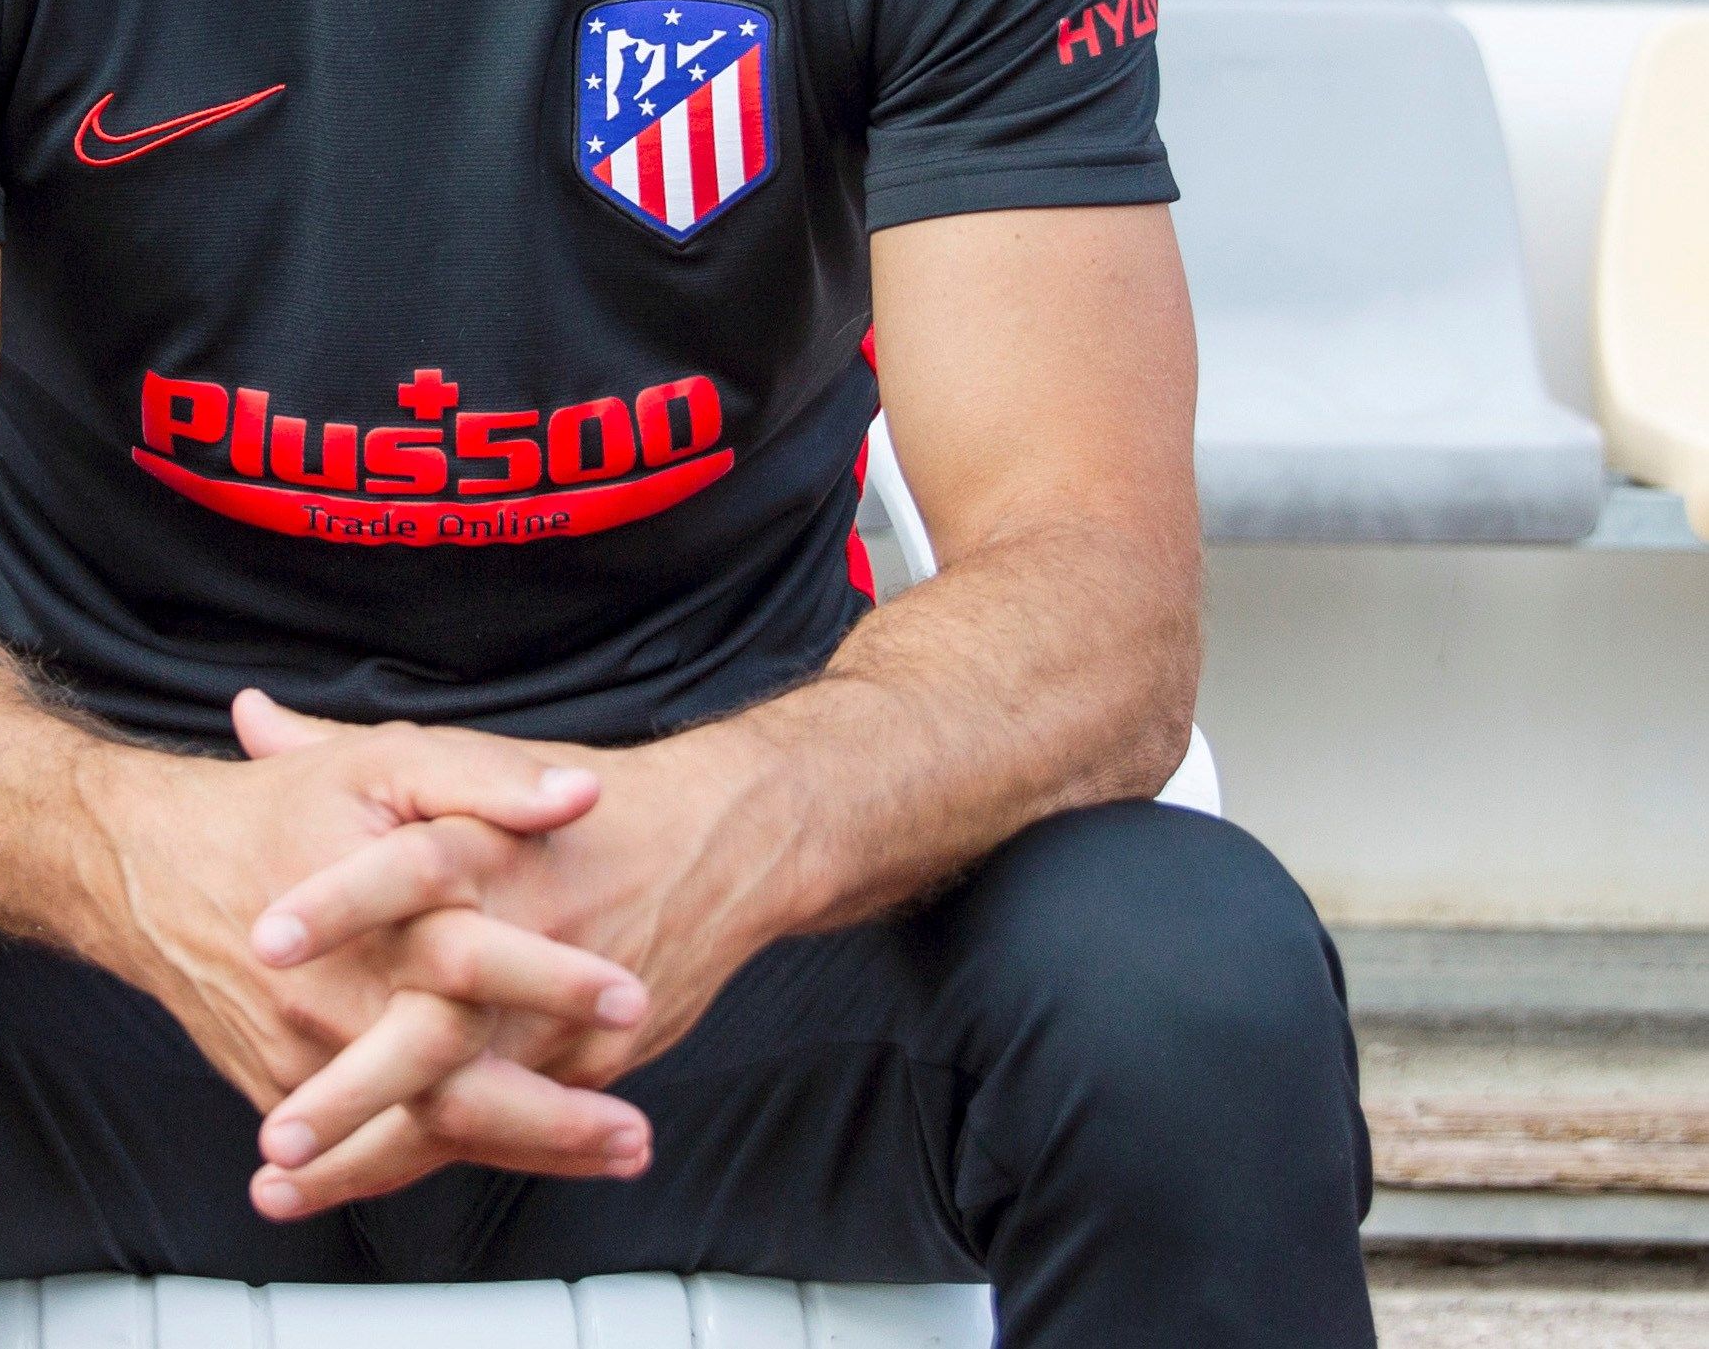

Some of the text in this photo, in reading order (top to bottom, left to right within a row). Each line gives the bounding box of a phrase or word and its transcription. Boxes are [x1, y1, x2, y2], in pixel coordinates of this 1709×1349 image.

[141, 368, 723, 495] Plus500
[303, 504, 571, 539] Trade Online
